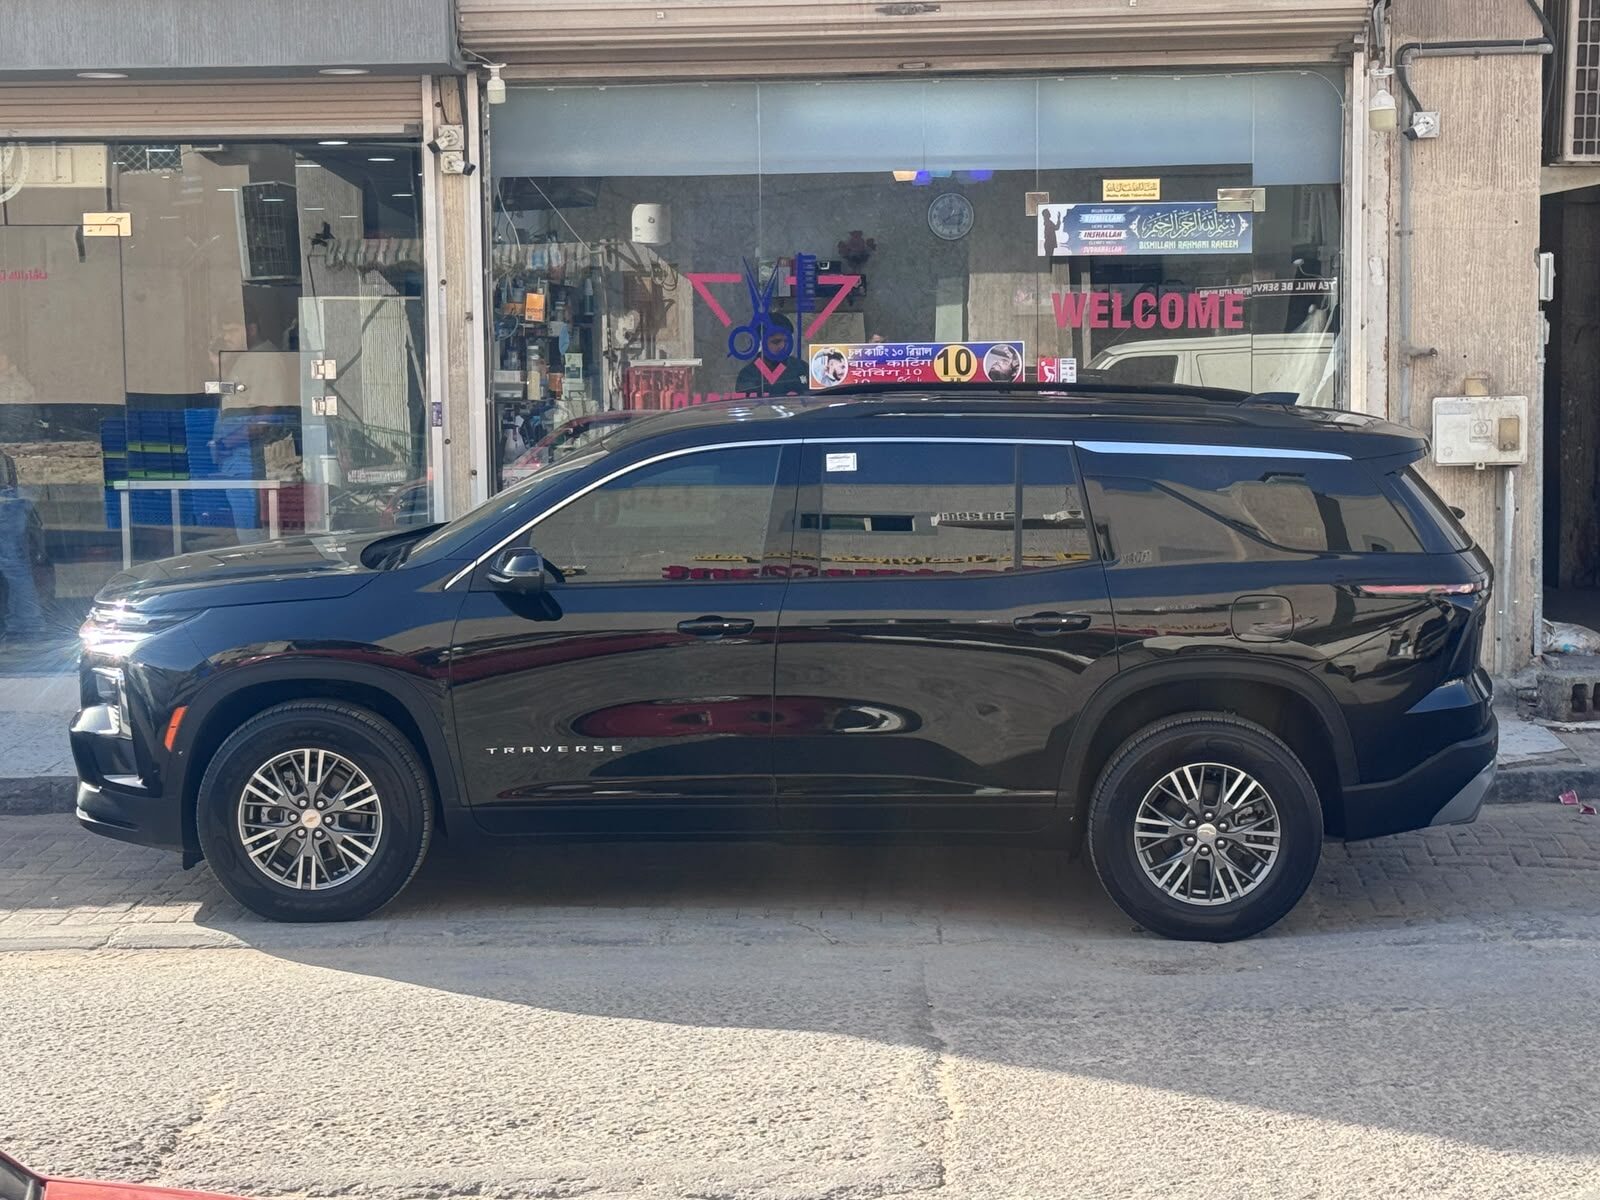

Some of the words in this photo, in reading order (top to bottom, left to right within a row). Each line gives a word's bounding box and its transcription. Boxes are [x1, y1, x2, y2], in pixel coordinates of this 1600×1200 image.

[1083, 231, 1123, 239] INSHALLAH
[1178, 240, 1209, 249] RAHMANI
[1211, 239, 1239, 249] RAHEEM
[1051, 291, 1244, 329] WELCOME
[864, 345, 889, 357] কাটিং
[892, 348, 904, 357] ১০
[937, 348, 972, 376] 10
[905, 368, 922, 376] 10
[485, 745, 623, 754] TRAVERSE
